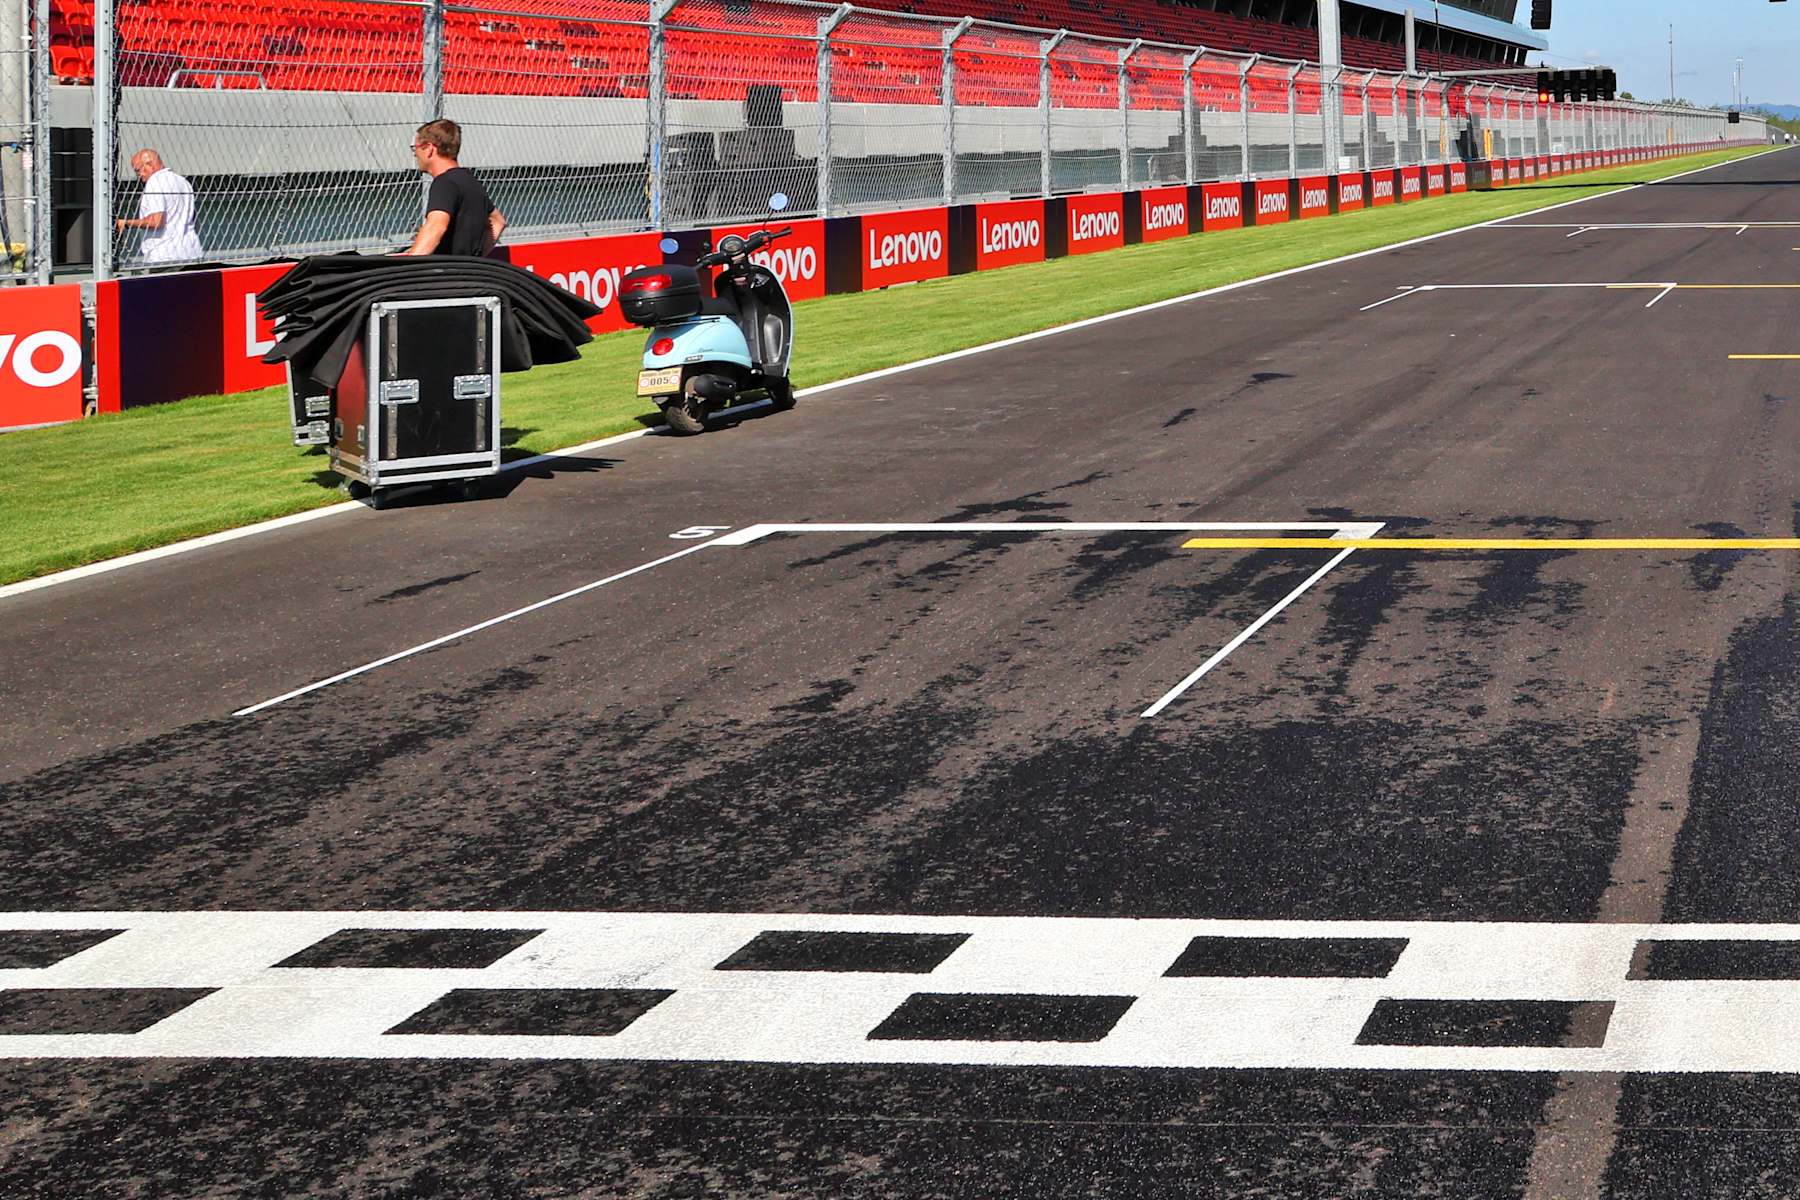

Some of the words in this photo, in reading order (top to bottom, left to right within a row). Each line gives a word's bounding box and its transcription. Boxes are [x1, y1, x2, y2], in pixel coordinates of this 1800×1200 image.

[1339, 181, 1362, 204] Lenovo
[1372, 178, 1393, 198] Lenovo
[1401, 174, 1420, 194] Lenovo
[1205, 192, 1240, 220] Lenovo
[1257, 190, 1287, 215] Lenovo
[1301, 186, 1327, 209] Lenovo
[1072, 208, 1120, 241] Lenovo
[1145, 201, 1185, 231] Lenovo
[982, 217, 1040, 254] Lenovo
[869, 228, 942, 270] Lenovo
